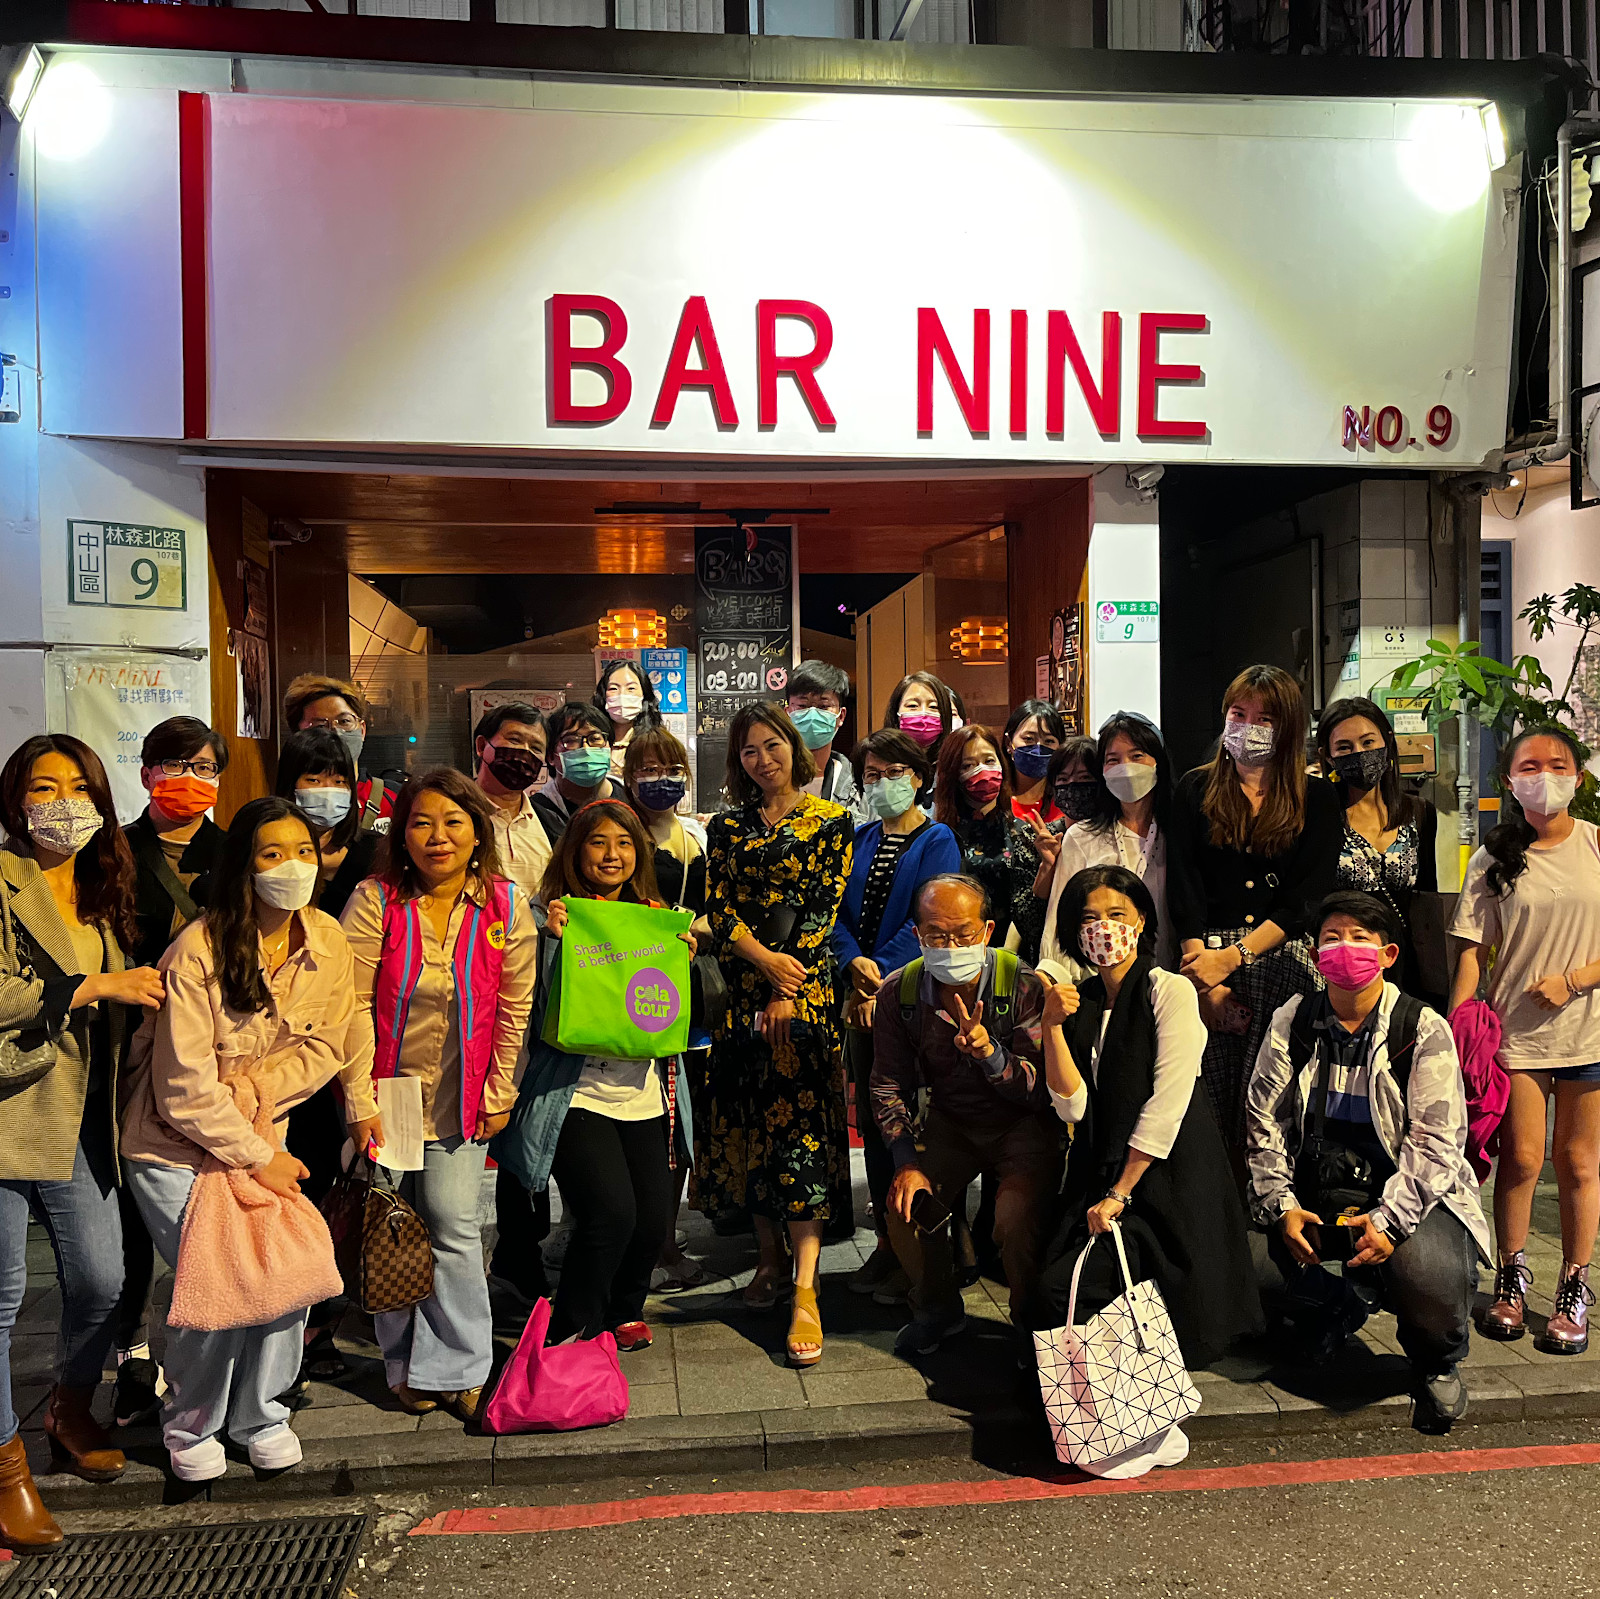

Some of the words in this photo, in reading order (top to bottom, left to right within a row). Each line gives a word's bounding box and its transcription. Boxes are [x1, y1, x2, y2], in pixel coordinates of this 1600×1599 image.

[548, 294, 838, 428] BAR
[917, 307, 1209, 441] NINE
[105, 526, 182, 550] 林森北路
[78, 531, 100, 594] 中山區
[156, 550, 180, 561] 107巷
[130, 558, 159, 600] 9
[716, 595, 783, 608] WELCOME
[1119, 602, 1158, 613] 林森北路
[707, 606, 781, 629] 營業時間
[1124, 623, 1135, 639] 9
[704, 641, 759, 661] 20:00
[706, 670, 758, 691] 03:00
[574, 941, 613, 956] Share
[578, 959, 587, 968] a
[589, 951, 629, 967] better
[631, 942, 666, 959] world
[634, 983, 671, 1003] cola
[634, 998, 671, 1018] tour
